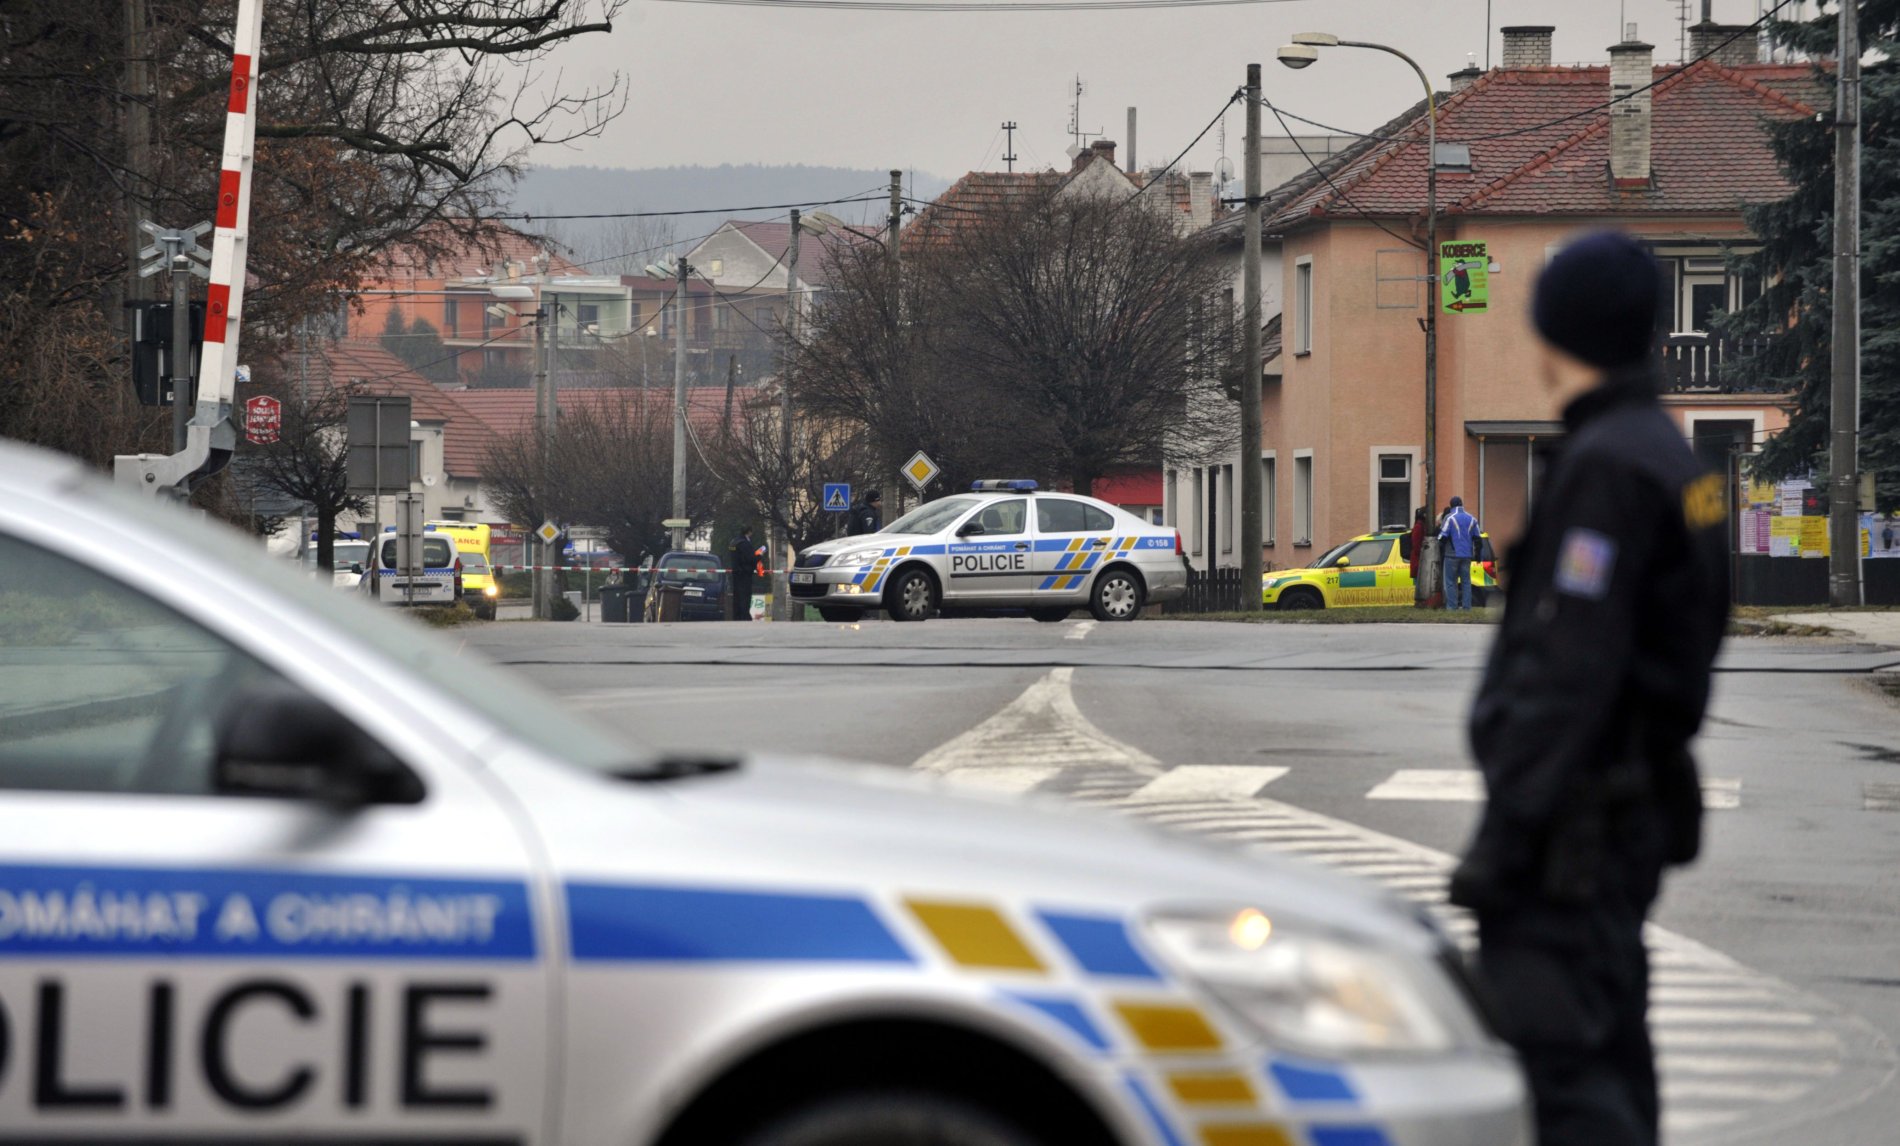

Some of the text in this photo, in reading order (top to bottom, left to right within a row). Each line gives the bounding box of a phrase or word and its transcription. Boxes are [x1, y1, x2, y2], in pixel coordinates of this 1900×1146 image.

[1442, 243, 1486, 258] KOBERCE
[452, 537, 481, 546] LANCE
[952, 554, 1025, 571] POLICIE
[1327, 577, 1339, 585] 217
[1335, 587, 1415, 605] AMBULANC
[0, 882, 499, 944] OMÁHAT A CHRÁNIT
[0, 974, 496, 1114] LICIE
